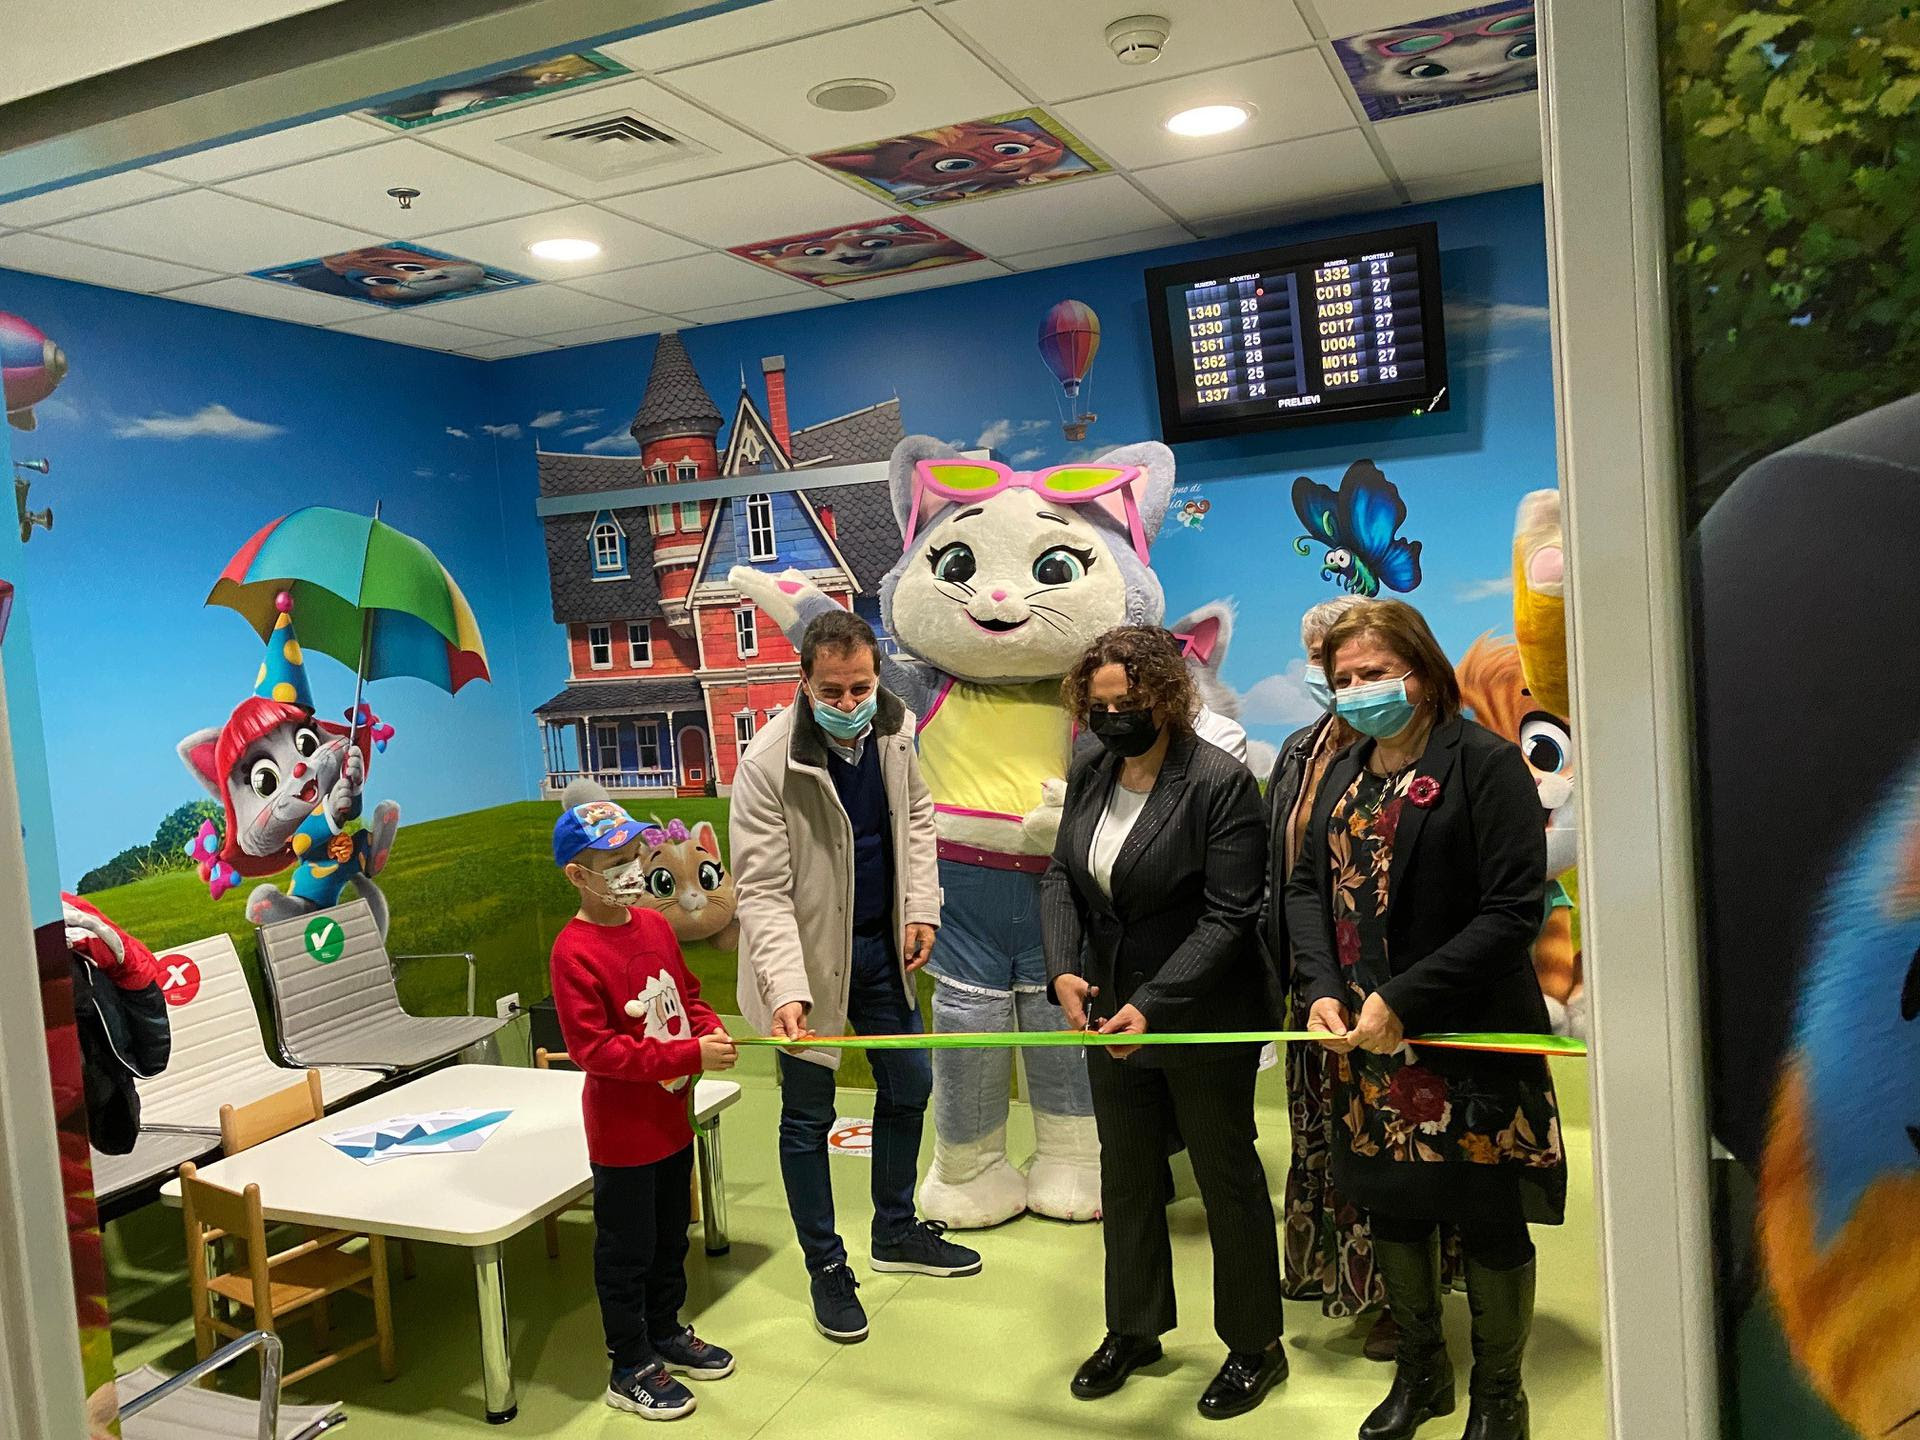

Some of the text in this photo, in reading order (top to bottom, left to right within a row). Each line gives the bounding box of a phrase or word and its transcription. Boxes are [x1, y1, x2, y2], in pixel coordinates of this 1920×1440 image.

[1324, 252, 1394, 268] NUMERO SPORTELLO
[1194, 273, 1260, 289] NUMERO SPORTELLO
[1315, 261, 1389, 283] L332 21
[1317, 278, 1390, 300] C019 27
[1188, 299, 1258, 320] L340 26
[1318, 296, 1392, 318] A039 24
[1190, 316, 1259, 337] L330 27
[1320, 313, 1393, 335] C017 27
[1192, 333, 1261, 354] L361 25
[1321, 331, 1395, 352] U004 27
[1193, 350, 1263, 370] L362 28
[1322, 348, 1396, 369] M014 27
[1195, 367, 1264, 387] C024 25
[1324, 366, 1398, 386] C015 26
[1197, 383, 1266, 403] L337 24
[1278, 395, 1320, 408] PRELIEVI
